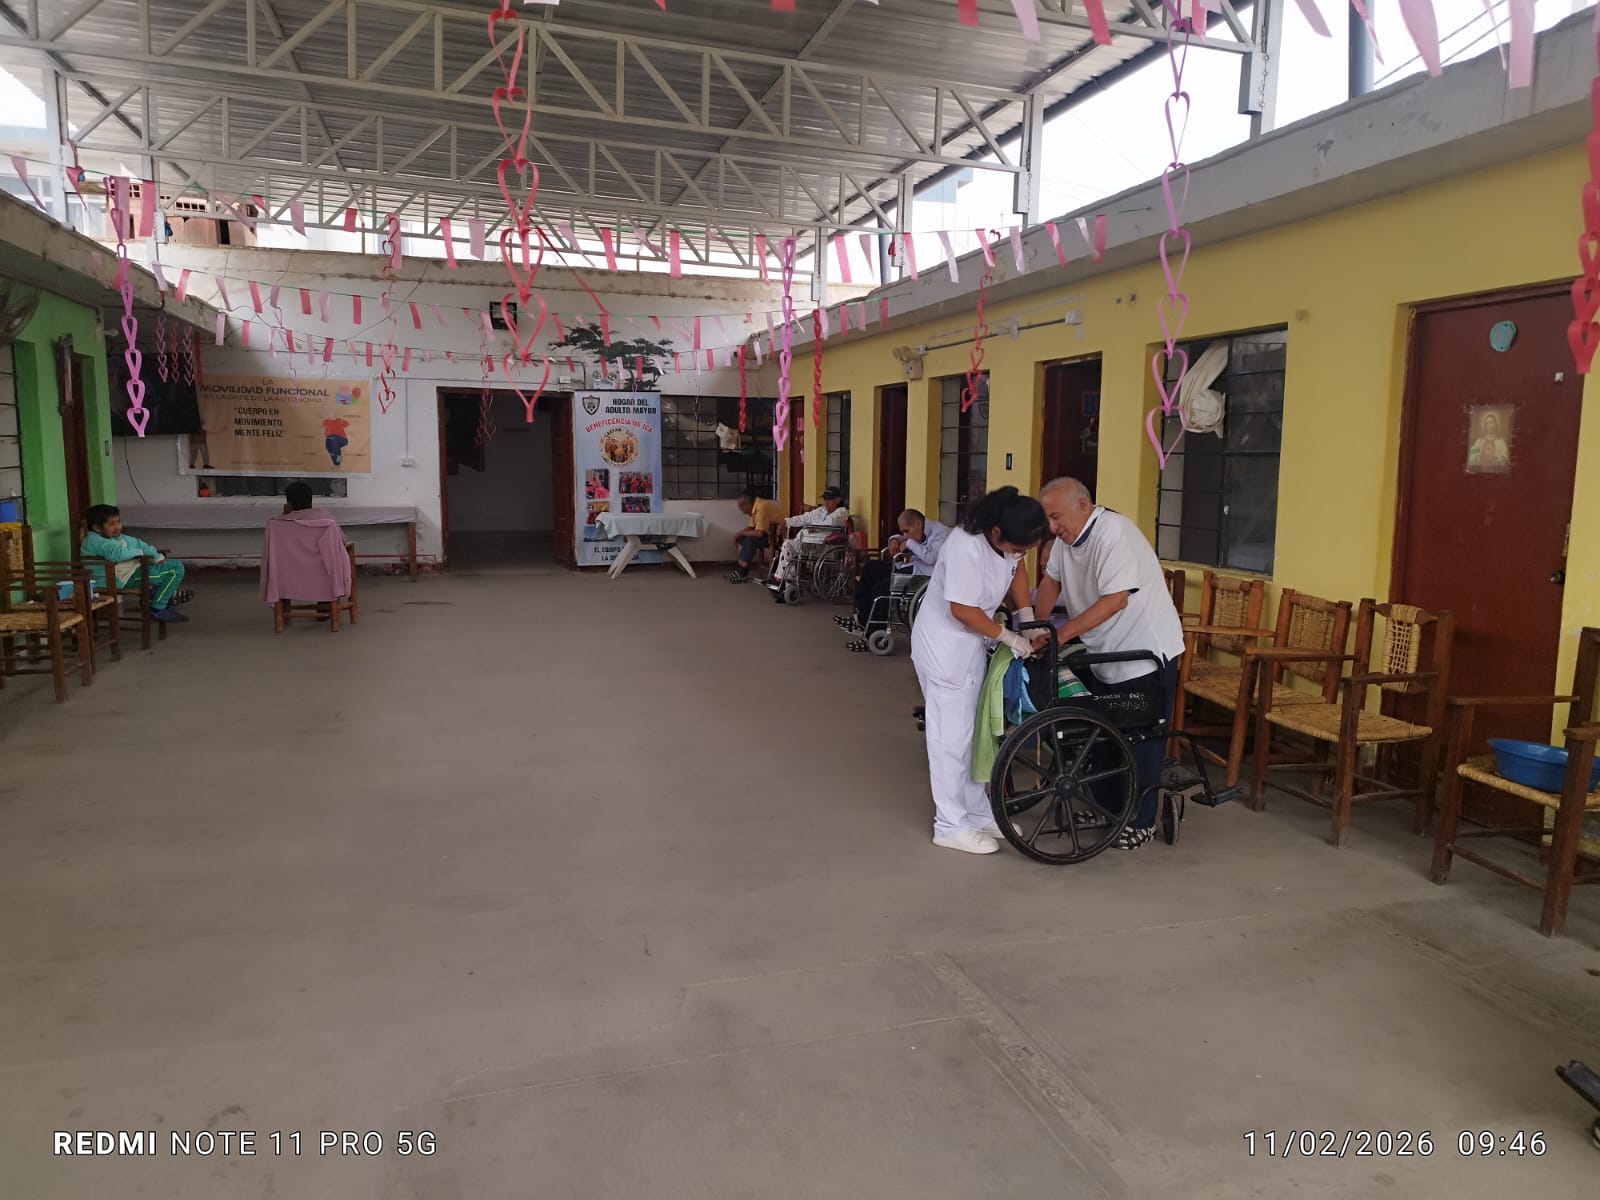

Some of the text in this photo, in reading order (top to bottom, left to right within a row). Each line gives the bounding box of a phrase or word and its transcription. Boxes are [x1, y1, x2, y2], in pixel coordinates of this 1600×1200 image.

[200, 385, 329, 397] MOVILIDAD FUNCIONAL
[612, 398, 635, 406] HOGAR
[605, 406, 657, 415] ADULTO MAYOR
[585, 418, 631, 433] BENEFICENCIA
[642, 424, 653, 432] ICA
[235, 429, 261, 437] MENTE
